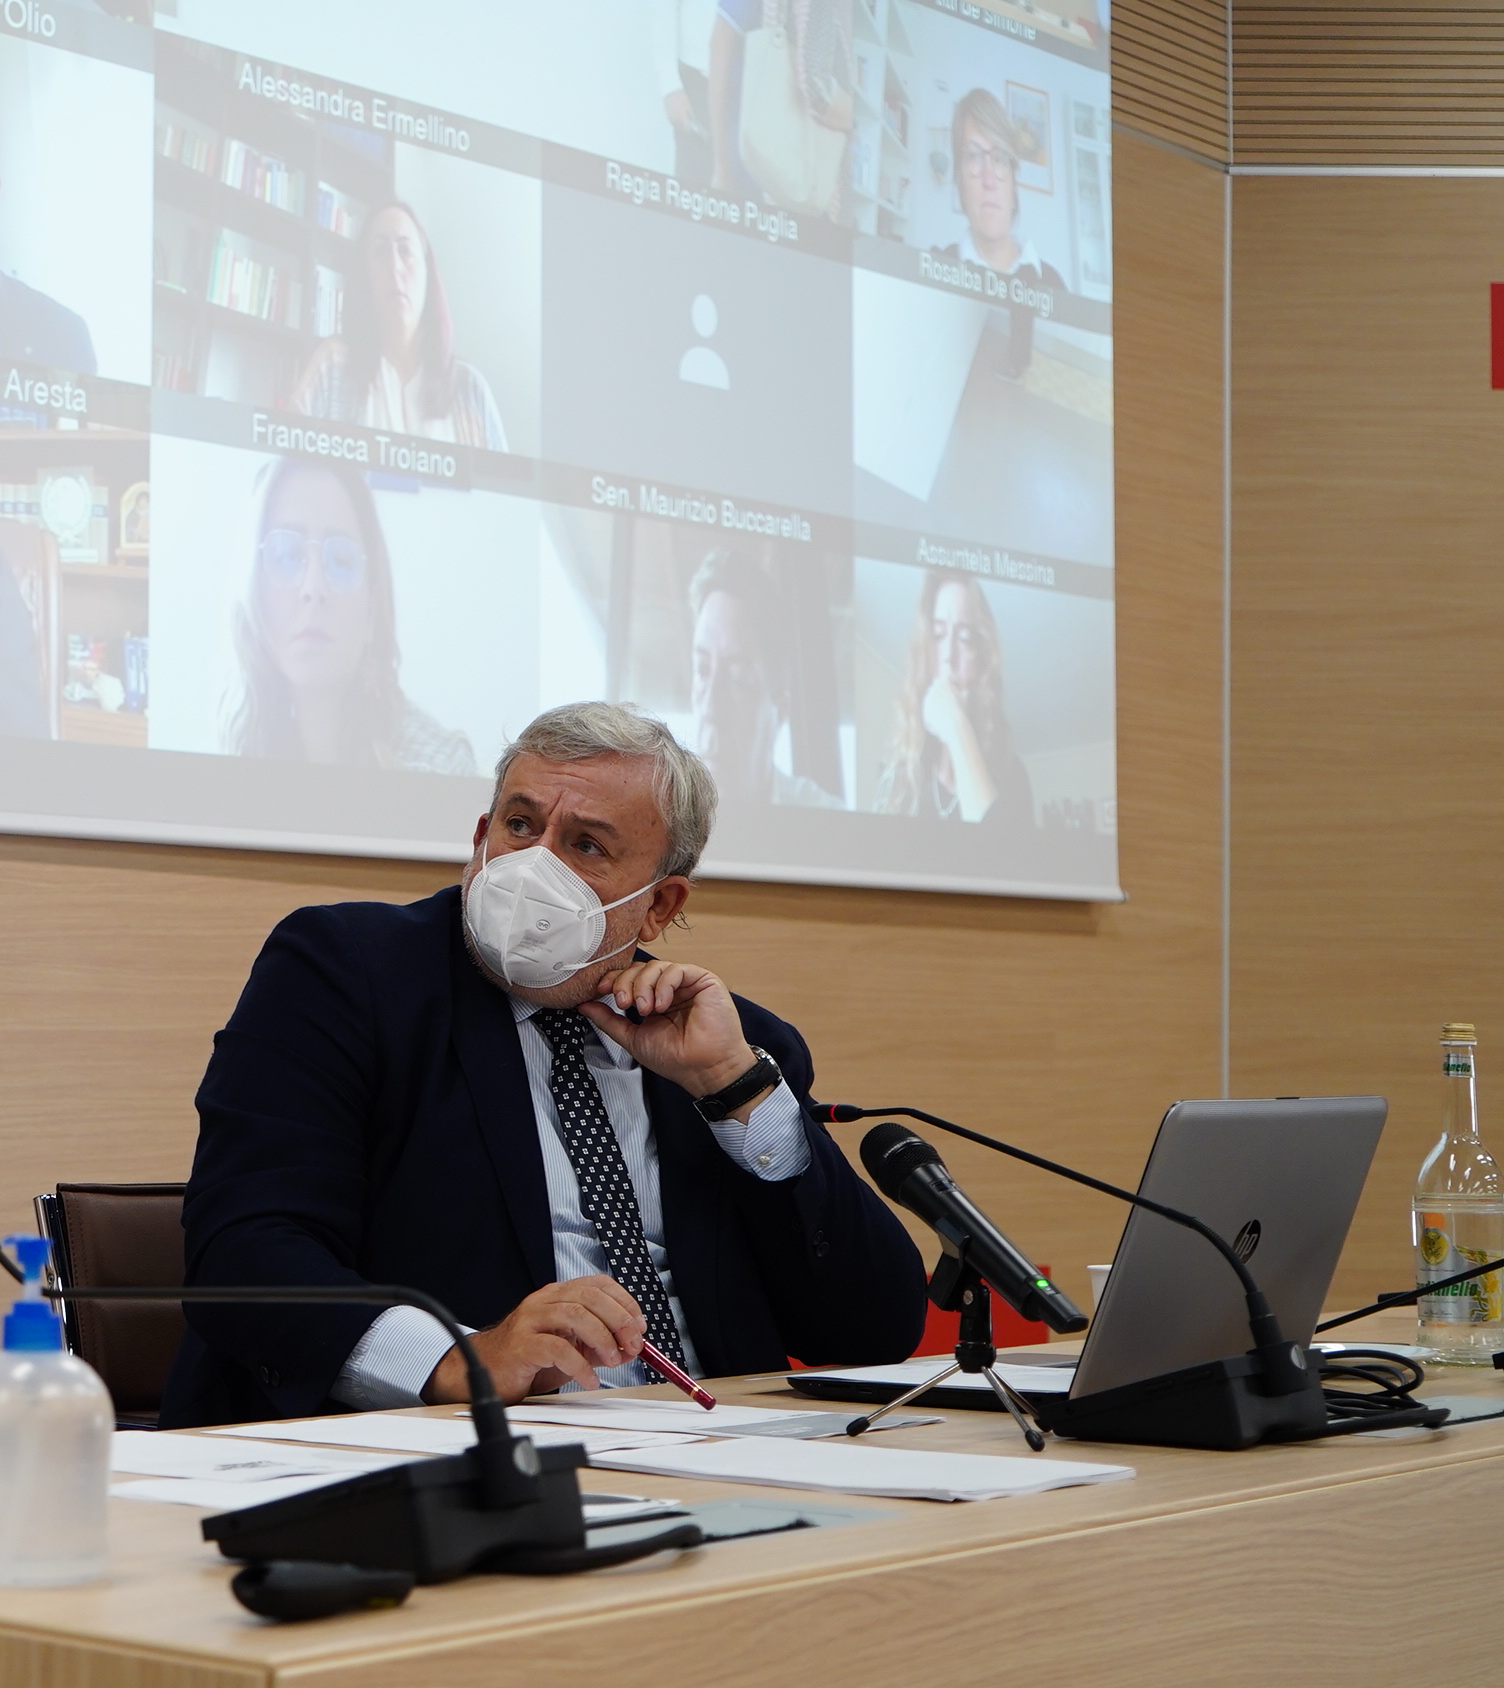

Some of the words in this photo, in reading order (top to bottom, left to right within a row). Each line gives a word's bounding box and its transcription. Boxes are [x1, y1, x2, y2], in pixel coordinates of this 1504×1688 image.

[238, 63, 366, 125] Alessandra
[372, 98, 471, 152] Ermellino
[606, 161, 661, 205] Regia
[665, 179, 741, 222] Regione
[745, 206, 799, 243] Puglia
[920, 252, 983, 293] Rosalba
[984, 270, 1008, 299] De
[1010, 278, 1055, 318] Giorgi
[3, 367, 88, 414] Aresta
[251, 413, 370, 463] Francesca
[374, 436, 457, 478] Troiano
[590, 475, 635, 511] Sen.
[639, 483, 718, 525] Maurizio
[721, 499, 812, 543] Buccarella
[994, 551, 1056, 587] Messina
[1234, 1220, 1259, 1260] hp
